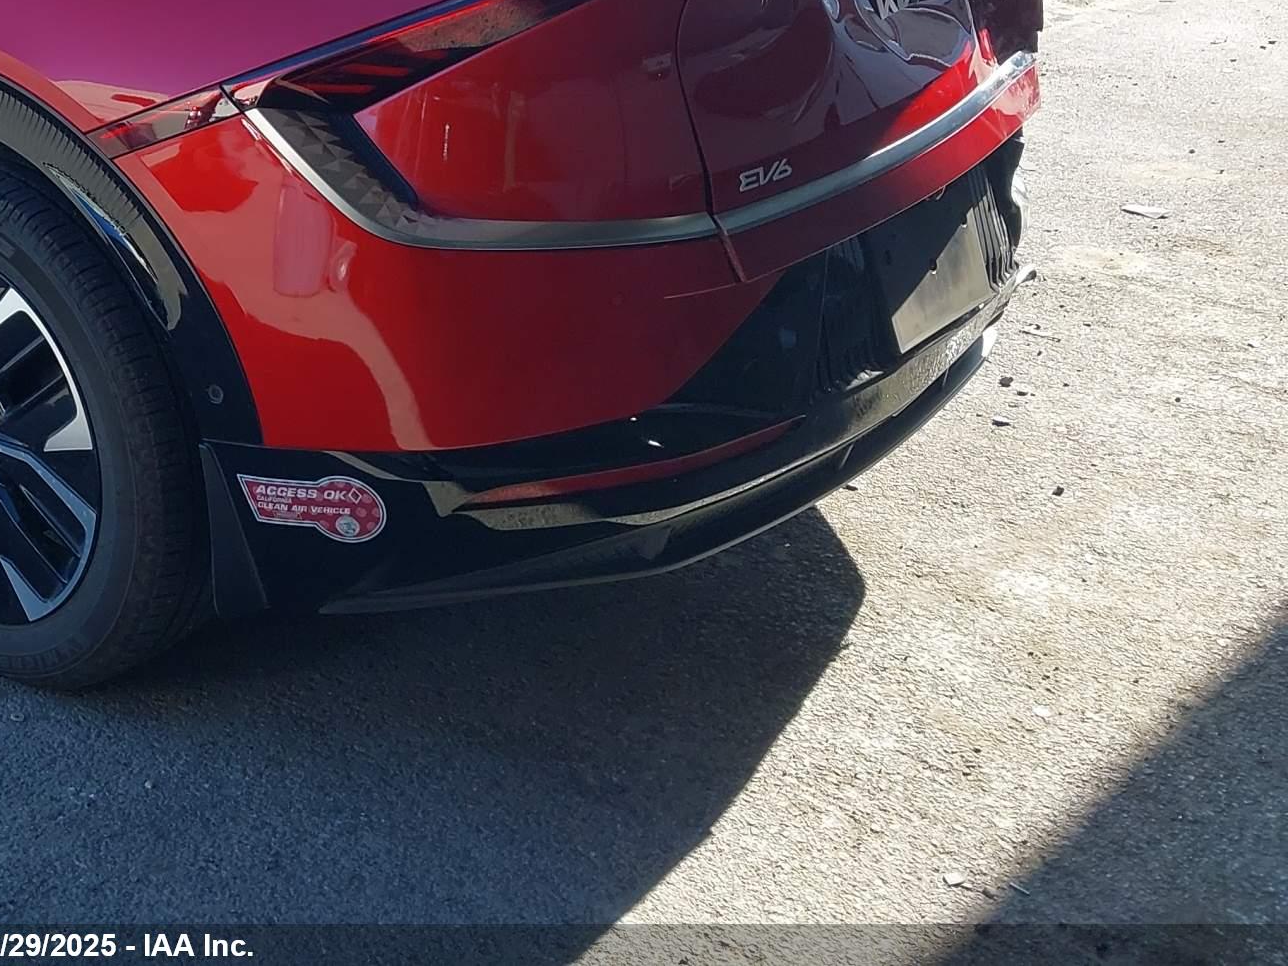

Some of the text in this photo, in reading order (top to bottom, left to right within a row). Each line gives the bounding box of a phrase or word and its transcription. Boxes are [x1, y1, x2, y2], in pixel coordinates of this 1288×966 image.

[739, 159, 792, 192] EV6
[256, 485, 347, 501] ACCESS OK
[257, 501, 288, 511] CLEAN
[291, 504, 307, 513] AIR
[311, 506, 351, 515] VEHICLE
